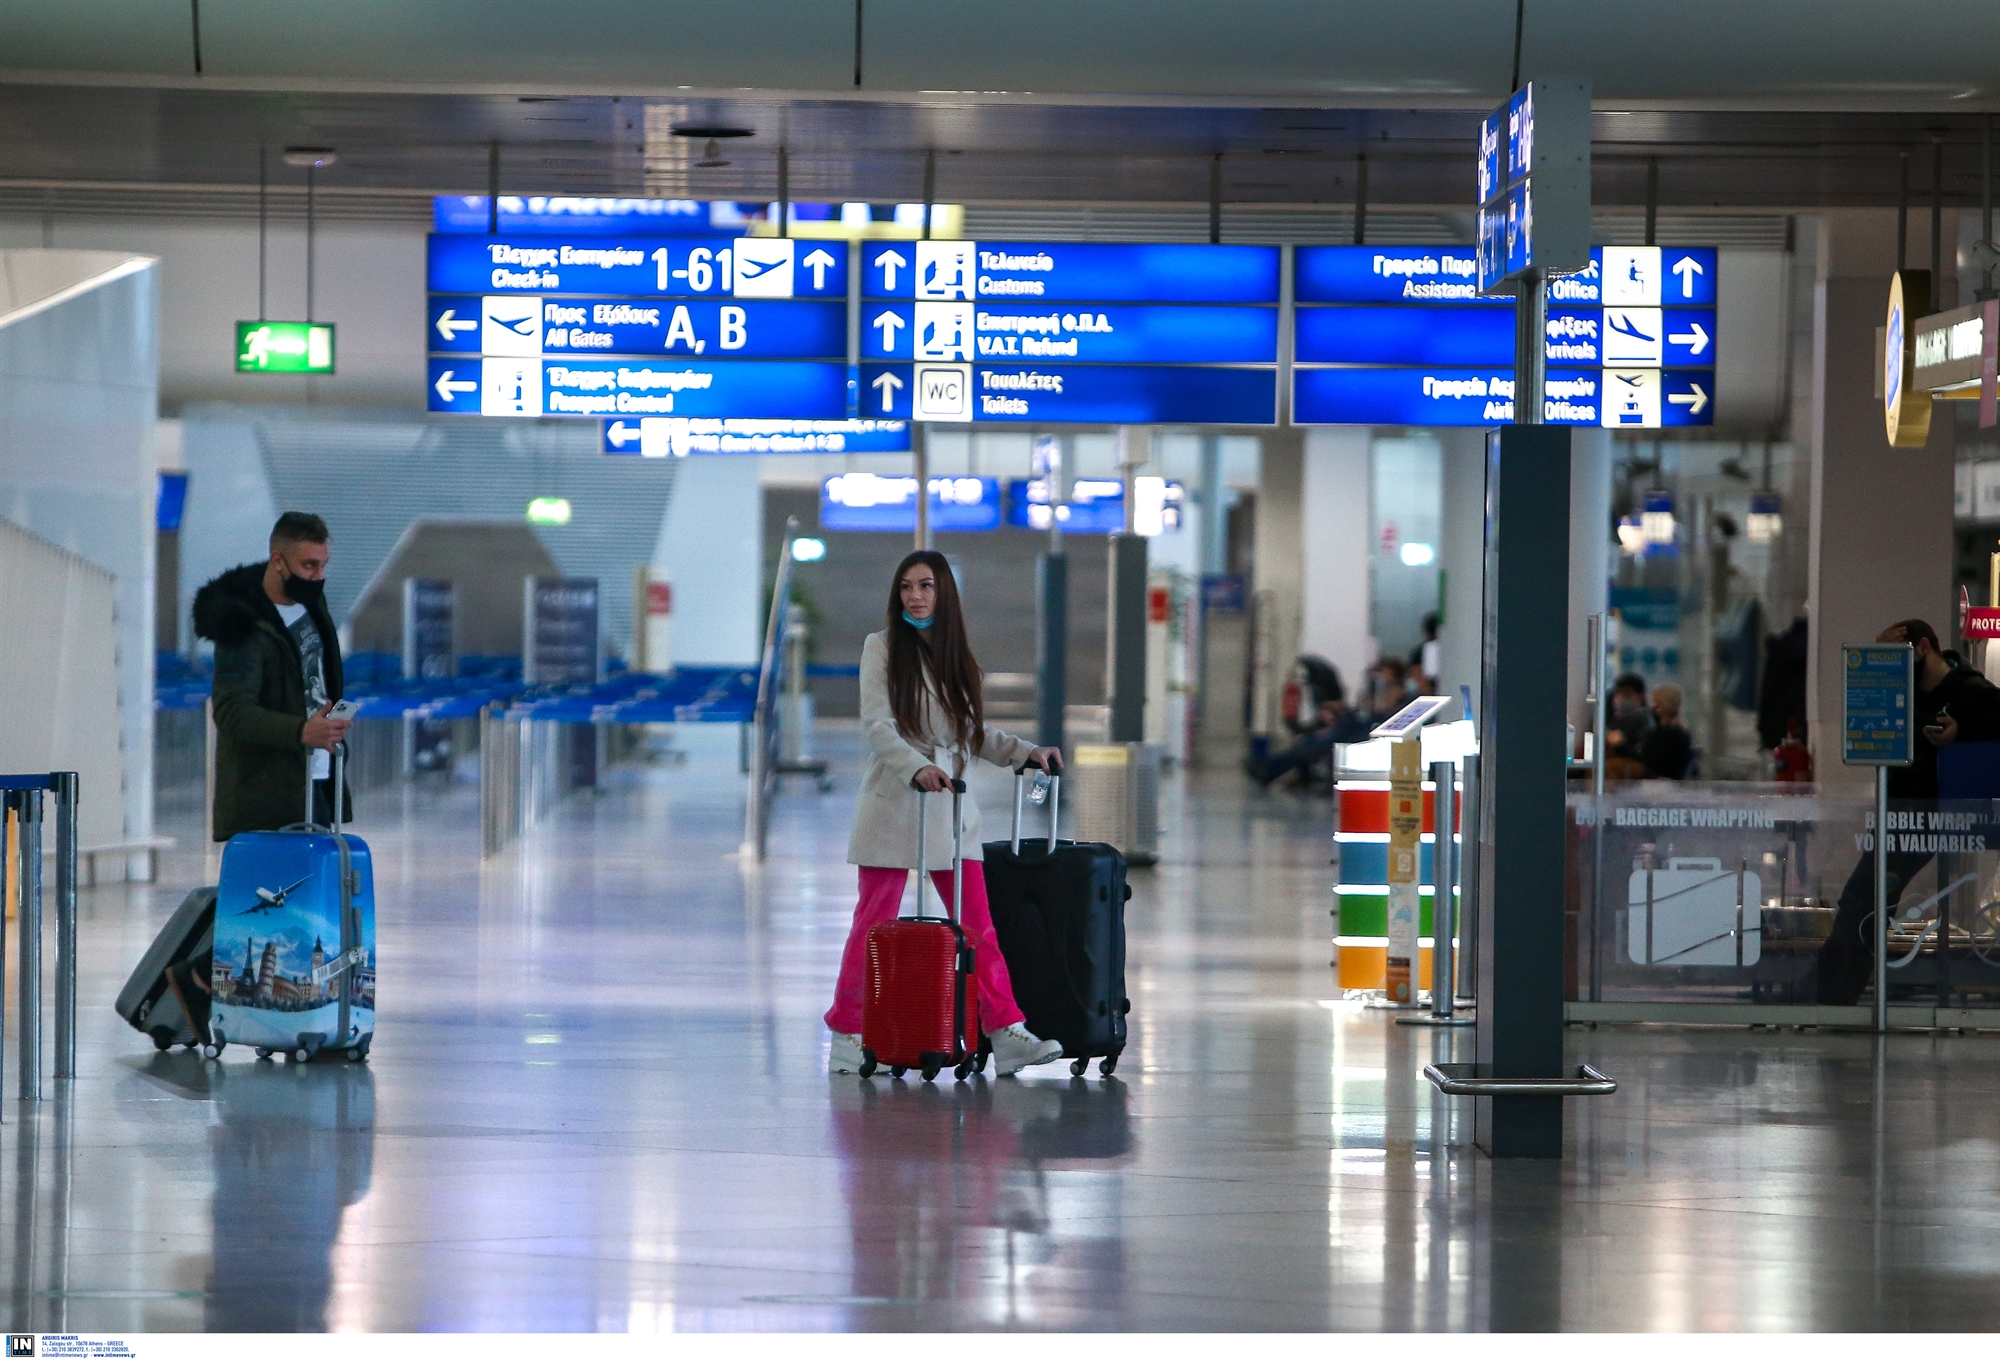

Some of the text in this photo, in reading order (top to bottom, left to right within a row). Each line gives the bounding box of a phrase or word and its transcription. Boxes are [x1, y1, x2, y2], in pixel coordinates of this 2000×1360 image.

[651, 247, 733, 292] 1-61
[979, 252, 1054, 271] Τελωνείο
[1373, 255, 1439, 278] Γραφείο
[491, 268, 560, 288] Check-in
[978, 275, 1045, 295] Customs
[1402, 280, 1476, 299] Assistanc
[1552, 280, 1599, 300] Office
[544, 303, 660, 328] Προς Εξόδους
[977, 312, 1060, 335] Επιστροφή
[664, 305, 748, 355] A, B
[1546, 316, 1598, 339] φίξεις
[545, 328, 614, 349] All Gates
[977, 336, 1078, 356] V.A.T. Refund
[927, 383, 958, 400] WC
[980, 371, 1064, 394] Τουαλέτες
[980, 395, 1029, 415] Toilets
[1545, 401, 1596, 421] Offices
[1615, 807, 1688, 827] BAGGAGE
[1691, 808, 1775, 828] WRAPPING
[1864, 811, 1925, 830] BBBLE
[1927, 812, 1977, 831] WRAP
[1854, 833, 1986, 853] YOR VALUABLES
